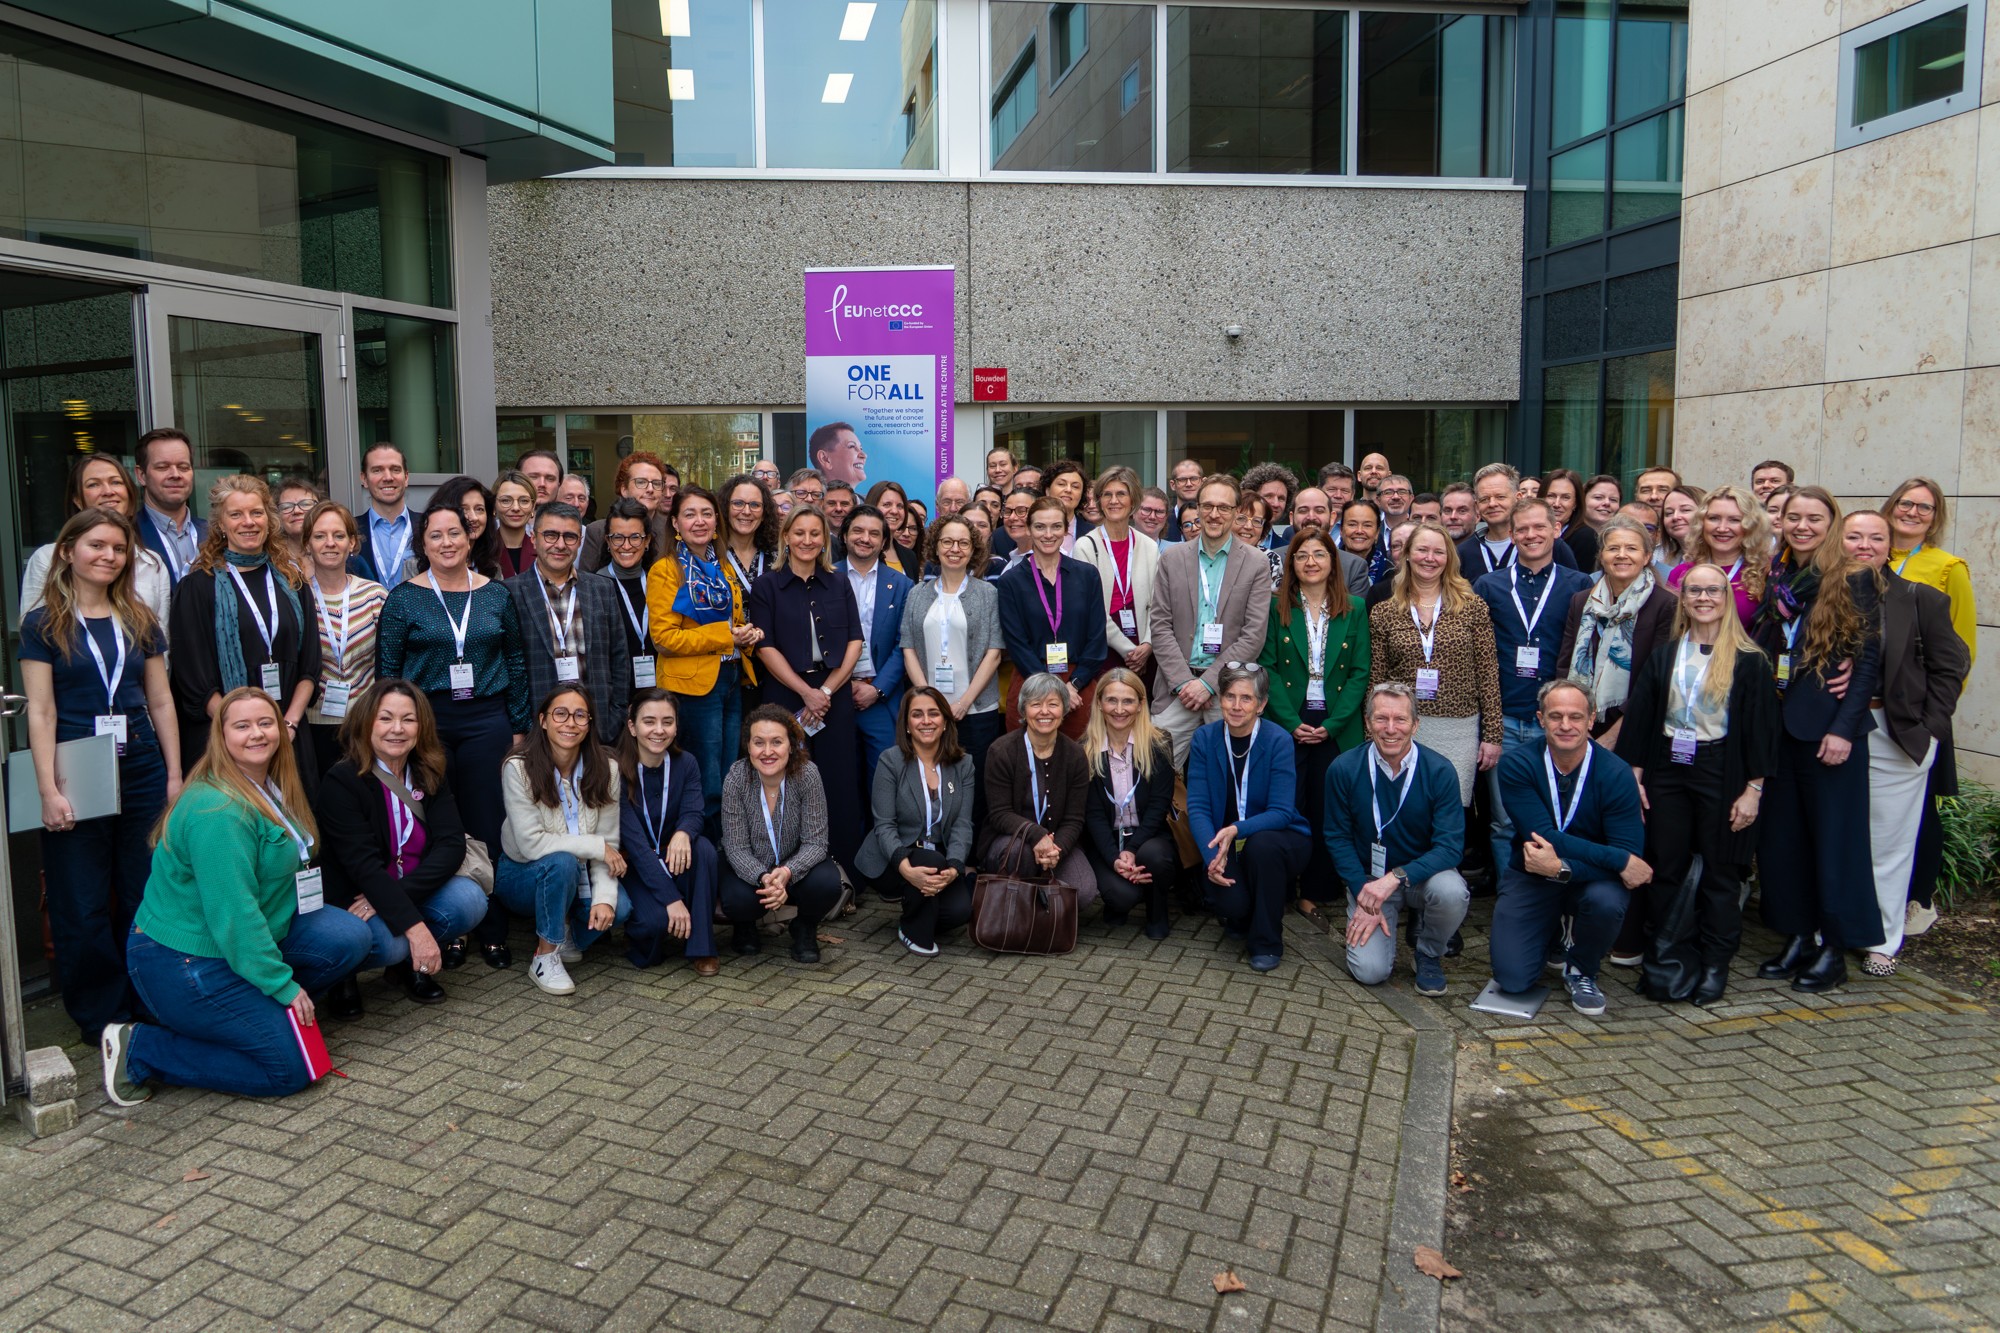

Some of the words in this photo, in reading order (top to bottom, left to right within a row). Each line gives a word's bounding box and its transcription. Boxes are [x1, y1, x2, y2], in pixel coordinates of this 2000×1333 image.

[844, 304, 923, 318] EUnetCCC
[847, 365, 891, 381] ONE
[987, 385, 994, 394] C
[941, 399, 948, 408] AT
